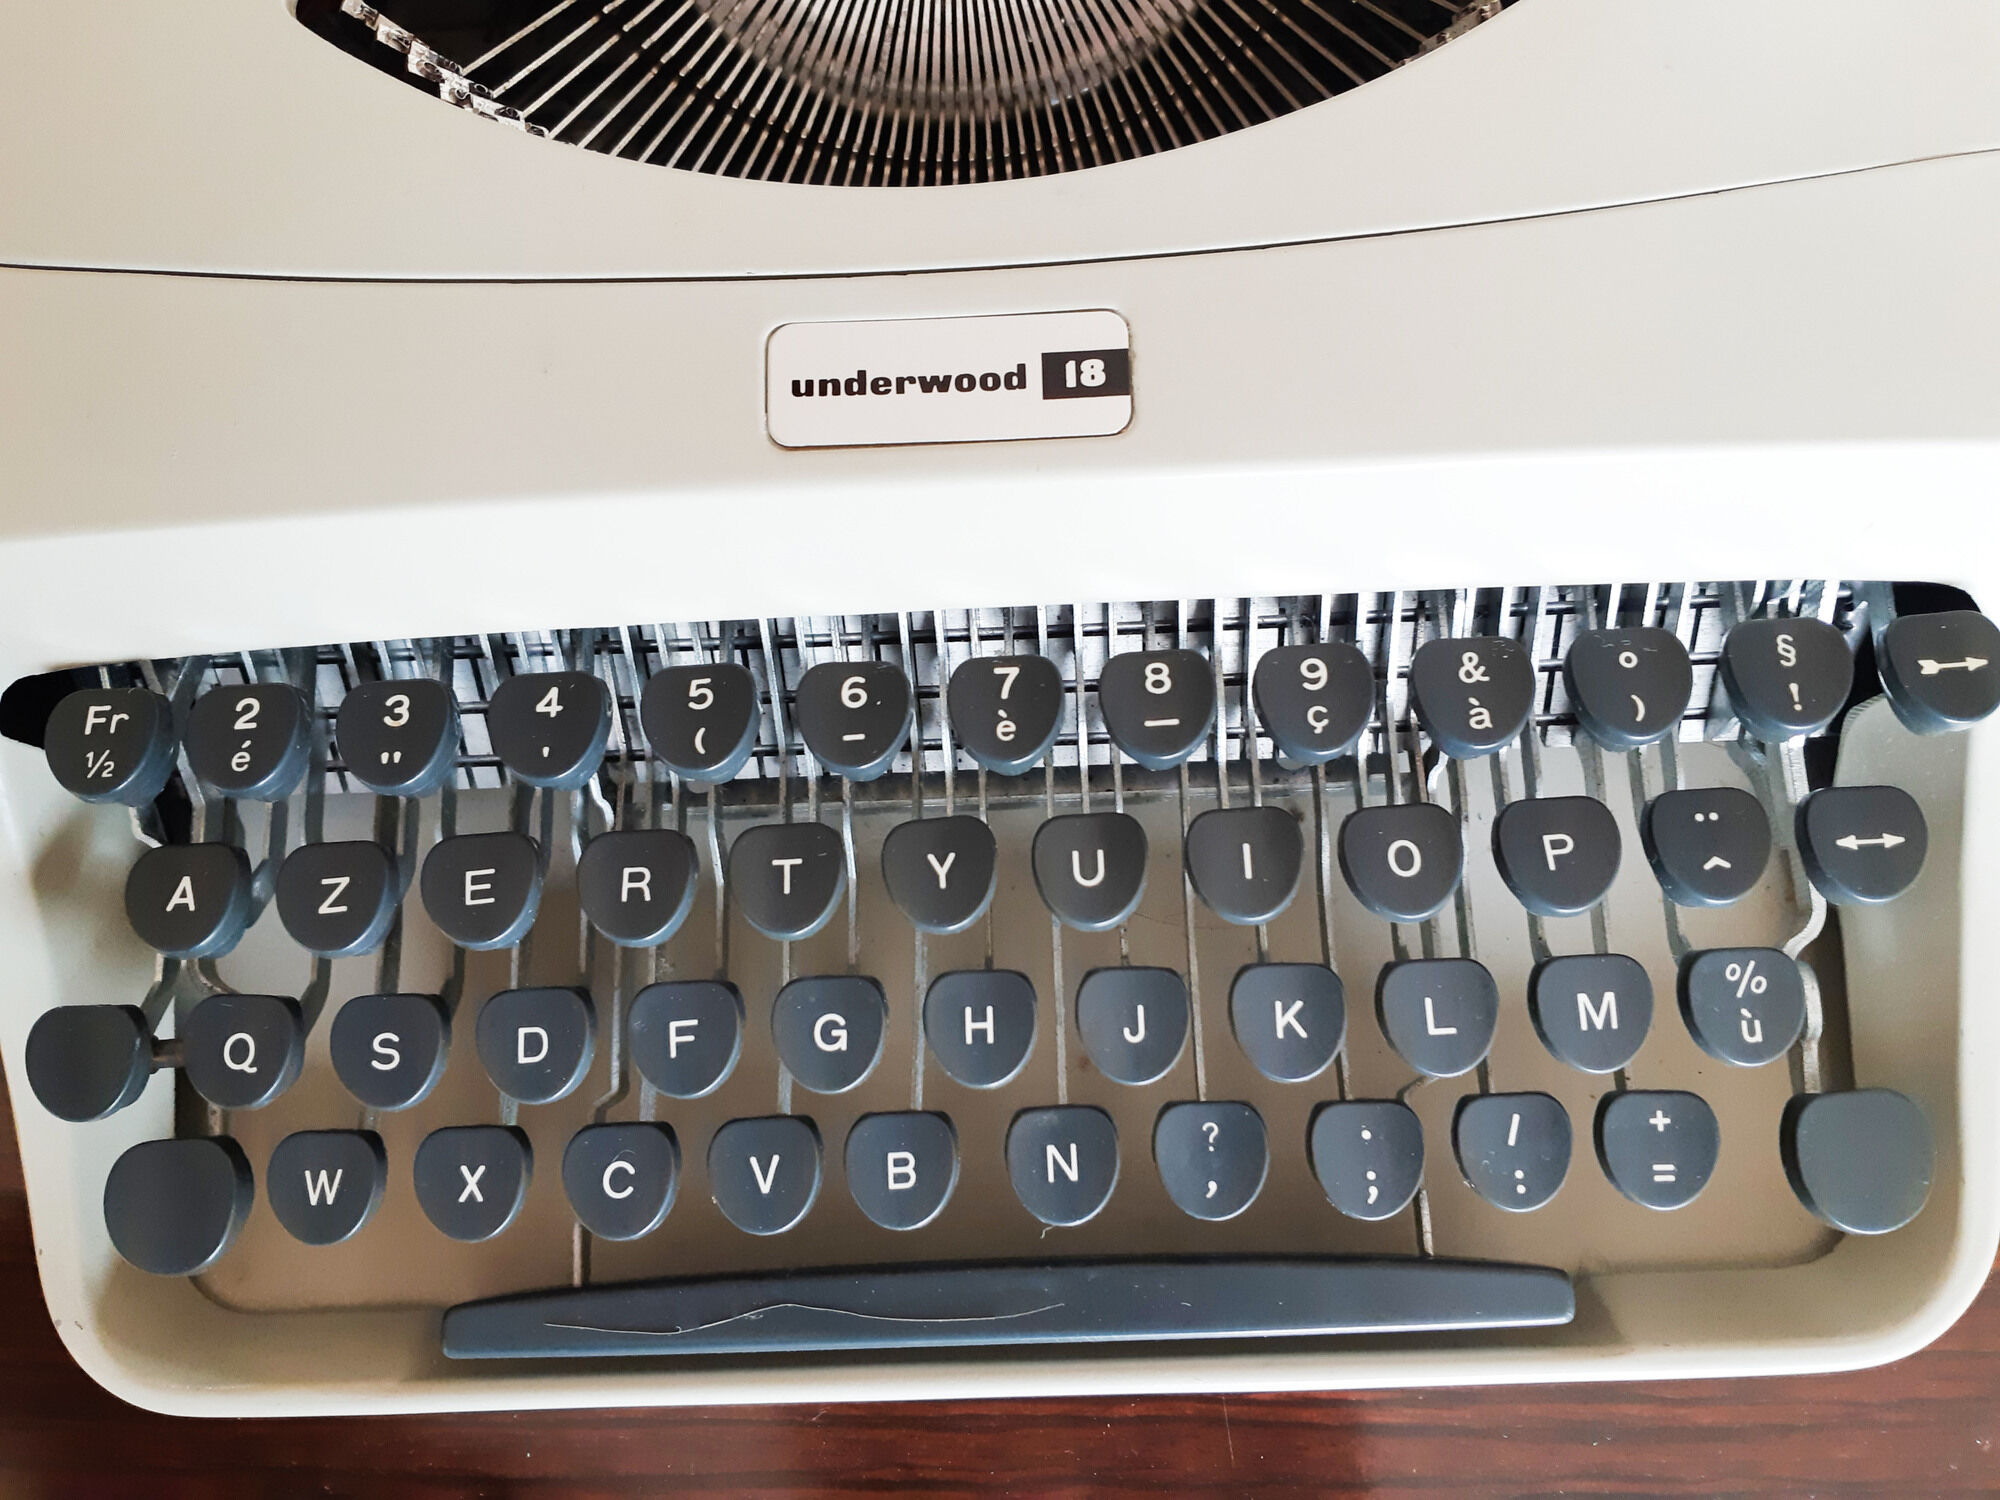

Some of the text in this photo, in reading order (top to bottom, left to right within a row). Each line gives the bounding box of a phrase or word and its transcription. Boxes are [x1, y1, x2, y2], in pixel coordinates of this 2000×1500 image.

[791, 358, 1107, 398] underwood 18
[1459, 652, 1489, 683] &
[1777, 634, 1796, 666] §
[994, 667, 1019, 699] 7
[1145, 663, 1171, 694] 8
[1300, 658, 1327, 690] 9
[536, 687, 563, 717] 4
[689, 678, 713, 709] 5
[841, 677, 867, 708] 6
[1631, 695, 1645, 721] )
[1789, 683, 1802, 710] !
[85, 705, 129, 735] Fr
[234, 698, 259, 729] 2
[384, 695, 409, 726] 3
[997, 710, 1016, 741] è
[1307, 706, 1328, 733] ç
[1469, 698, 1492, 729] à
[232, 740, 251, 771] é
[695, 728, 705, 754] (
[1072, 850, 1104, 886] U
[1243, 843, 1252, 879] I
[1388, 840, 1421, 877] O
[1543, 834, 1573, 870] P
[466, 869, 495, 905] E
[622, 867, 650, 902] R
[772, 859, 802, 894] T
[927, 853, 955, 889] Y
[166, 876, 195, 911] A
[318, 877, 350, 914] Z
[1726, 960, 1767, 998] %
[965, 1006, 994, 1044] H
[1124, 1005, 1145, 1043] J
[1275, 1001, 1307, 1039] K
[1425, 997, 1457, 1035] L
[1577, 992, 1618, 1030] M
[1741, 1008, 1762, 1043] ù
[518, 1027, 548, 1063] D
[670, 1020, 698, 1058] F
[814, 1014, 847, 1051] G
[224, 1033, 257, 1073] Q
[372, 1033, 400, 1070] S
[1202, 1122, 1218, 1151] ?
[1508, 1114, 1520, 1146] /
[1649, 1110, 1671, 1131] +
[603, 1161, 635, 1199] C
[750, 1155, 779, 1194] V
[888, 1152, 916, 1190] B
[1047, 1143, 1078, 1183] N
[1653, 1165, 1675, 1181] =
[305, 1169, 342, 1205] W
[459, 1165, 485, 1202] X
[1367, 1171, 1378, 1204] ;
[1515, 1170, 1526, 1194] :
